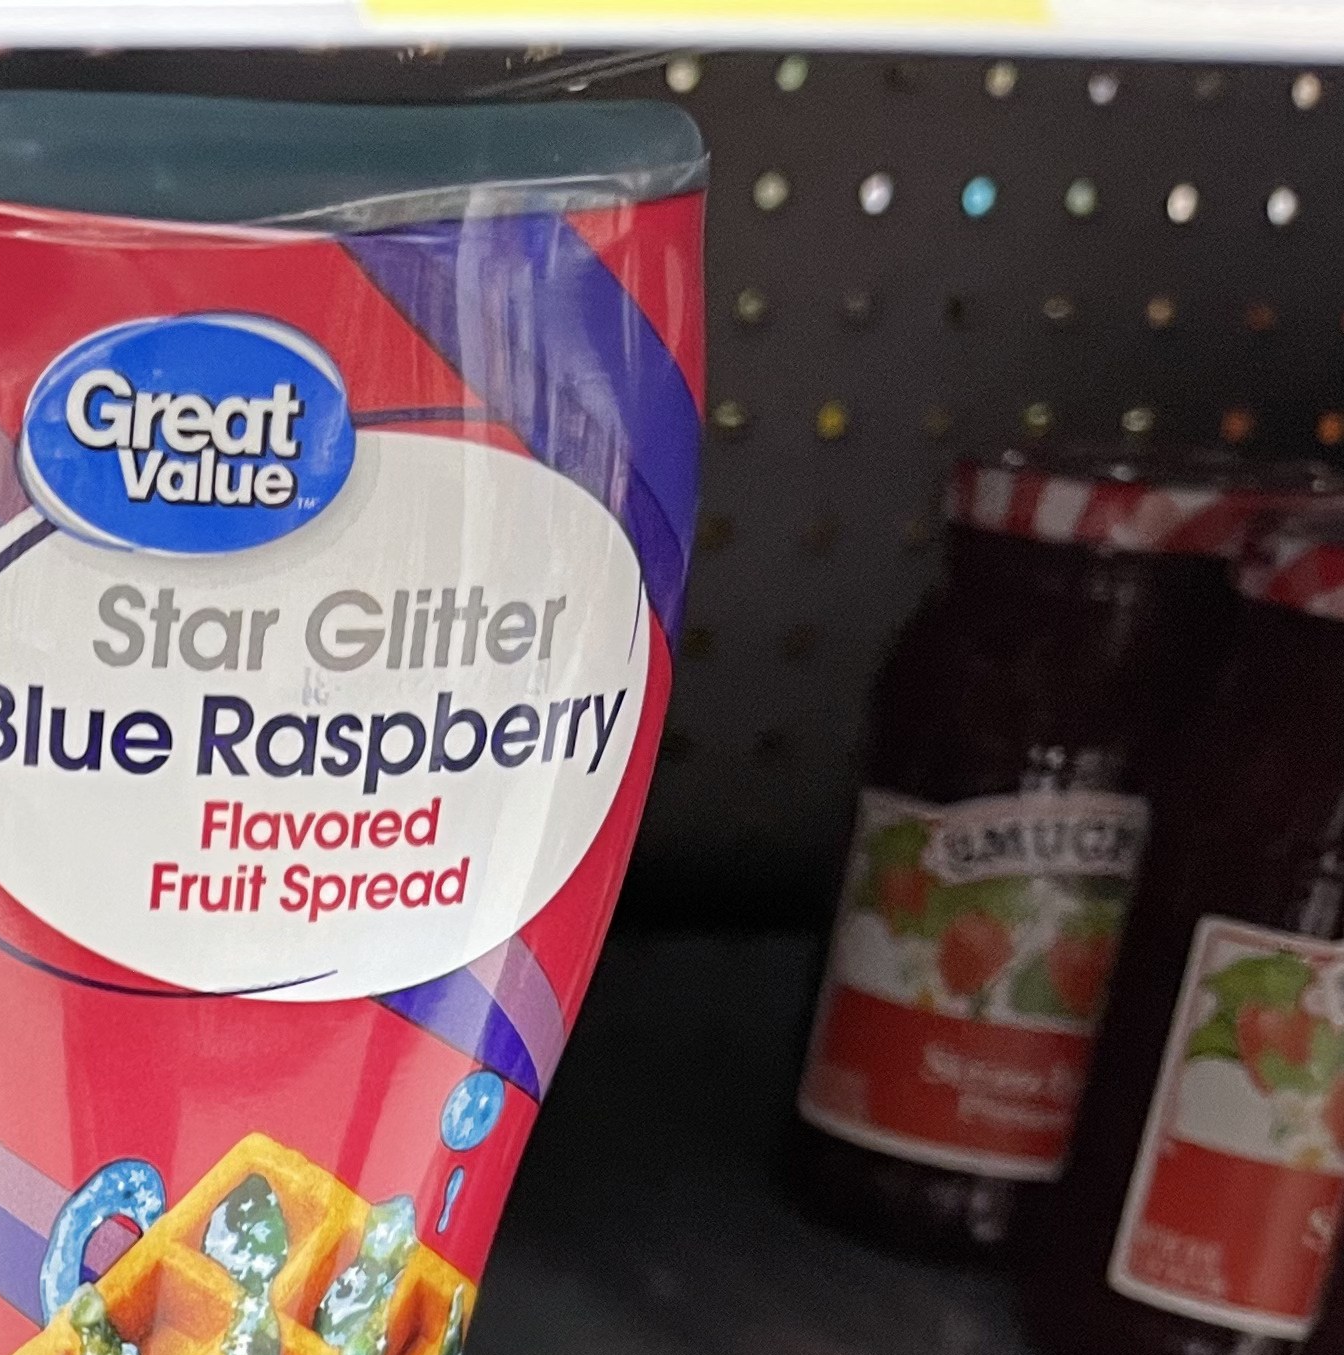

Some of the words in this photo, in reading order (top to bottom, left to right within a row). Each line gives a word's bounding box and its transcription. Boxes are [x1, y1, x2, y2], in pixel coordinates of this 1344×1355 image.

[64, 369, 304, 458] Great
[118, 446, 295, 506] Value
[92, 584, 280, 671] Star
[305, 585, 567, 671] Glitter
[196, 688, 628, 794] Raspberry
[200, 798, 443, 851] Flavored
[149, 862, 267, 912] Fruit
[279, 857, 470, 922] Spread
